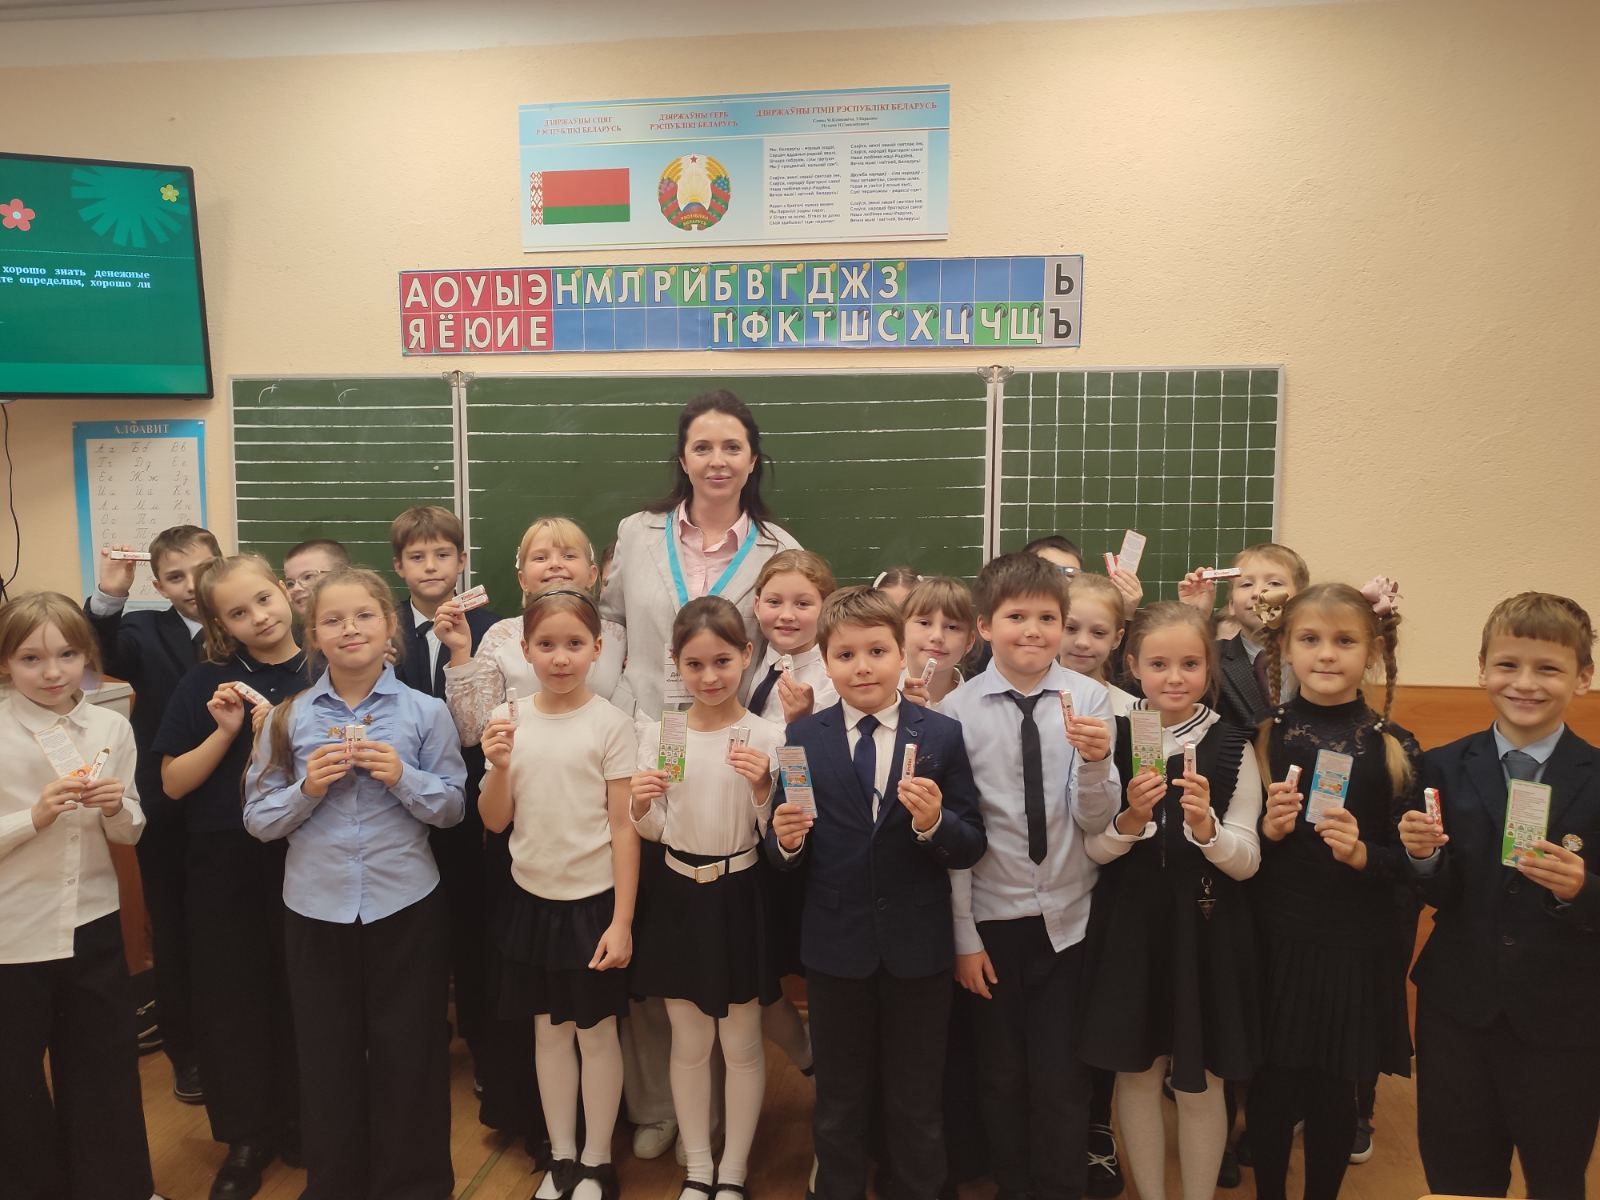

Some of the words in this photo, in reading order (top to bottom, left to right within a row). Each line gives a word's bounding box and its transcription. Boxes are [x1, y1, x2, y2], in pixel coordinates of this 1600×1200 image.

[891, 102, 937, 111] БЕЛАРУСЬ
[3, 266, 46, 275] хорошо
[55, 268, 86, 277] знать
[94, 269, 150, 279] денежные
[19, 276, 85, 287] определим,
[90, 280, 131, 289] хорошо
[405, 278, 428, 307] А
[434, 277, 458, 307] О
[466, 276, 486, 306] У
[496, 275, 519, 306] Ы
[528, 274, 546, 305] Э
[557, 273, 577, 304] Н
[585, 273, 612, 304] М
[619, 272, 639, 303] Л
[655, 271, 671, 302] Р
[684, 268, 706, 302] Й
[715, 270, 731, 301] Б
[747, 269, 764, 300] В
[781, 269, 797, 299] Г
[808, 268, 833, 304] Д
[840, 267, 869, 299] Ж
[879, 267, 898, 299] З
[1056, 264, 1074, 297] Ь
[409, 319, 425, 349] Я
[440, 314, 454, 348] Ё
[465, 317, 492, 348] Ю
[498, 317, 518, 347] И
[531, 316, 546, 346] Е
[714, 313, 733, 343] П
[742, 311, 768, 341] Ф
[779, 311, 799, 342] К
[813, 311, 831, 341] Т
[840, 310, 868, 341] Ш
[878, 310, 898, 341] С
[910, 309, 933, 341] Х
[945, 308, 969, 343] Ц
[981, 308, 1000, 339] Ч
[1010, 308, 1041, 343] Щ
[1050, 308, 1071, 341] Ъ
[114, 424, 169, 434] АЛФАВИТ
